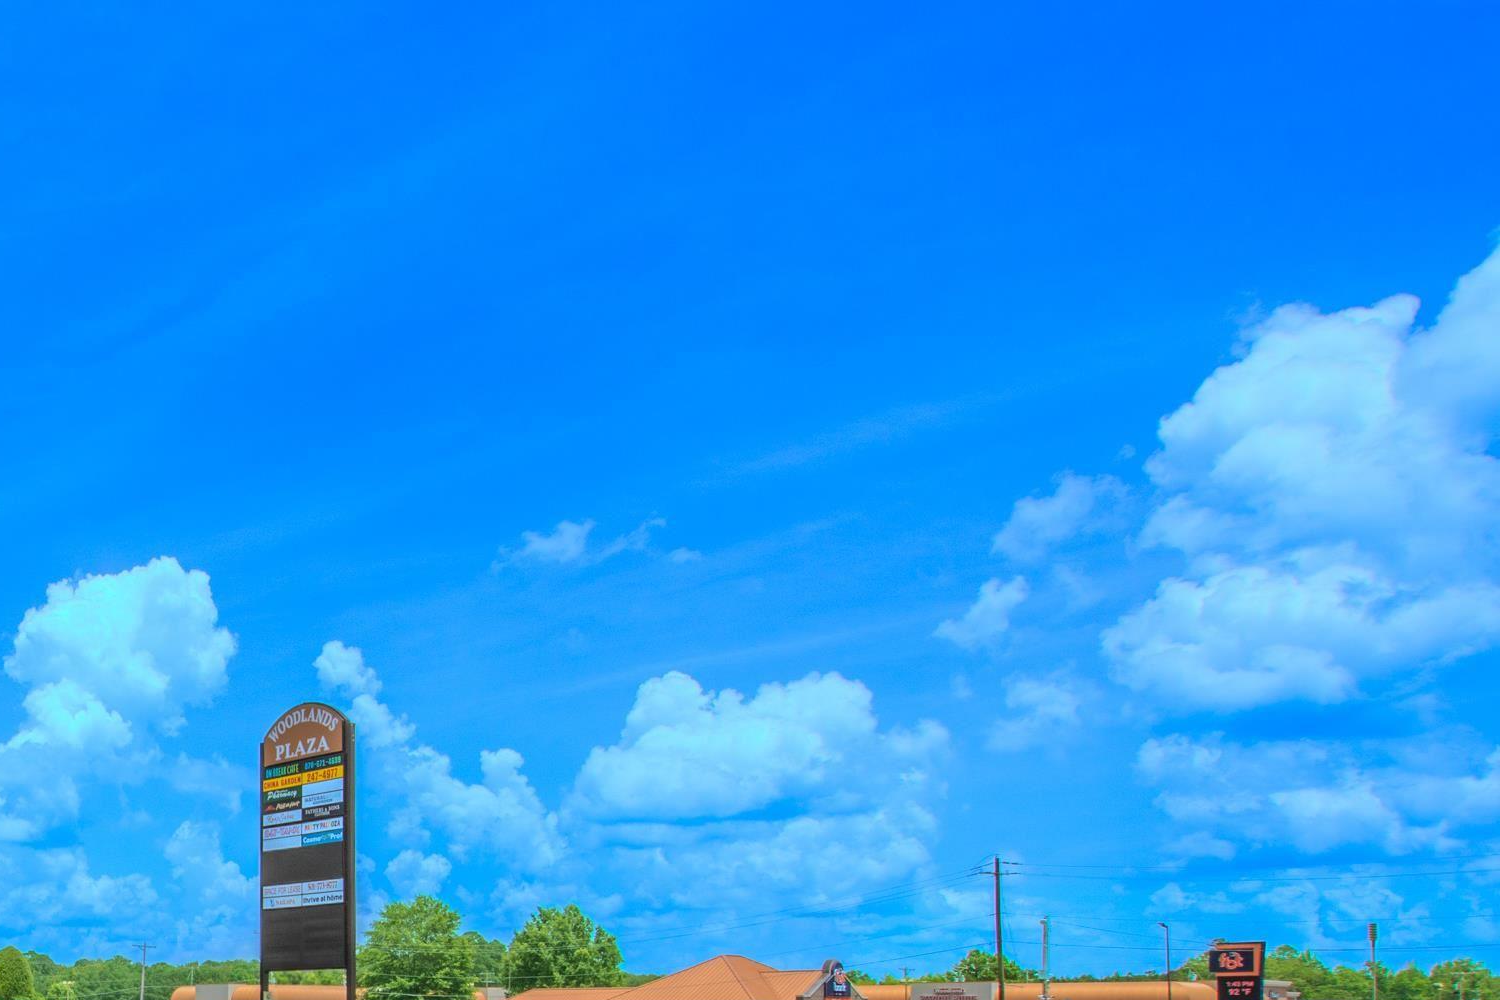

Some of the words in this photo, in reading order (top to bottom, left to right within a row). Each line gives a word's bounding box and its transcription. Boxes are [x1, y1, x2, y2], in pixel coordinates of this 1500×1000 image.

[268, 707, 339, 743] WOODLANDS
[275, 735, 330, 761] PLAZA
[264, 780, 279, 790] CHINA
[281, 776, 301, 787] GARDEN
[307, 767, 338, 783] 247-4977
